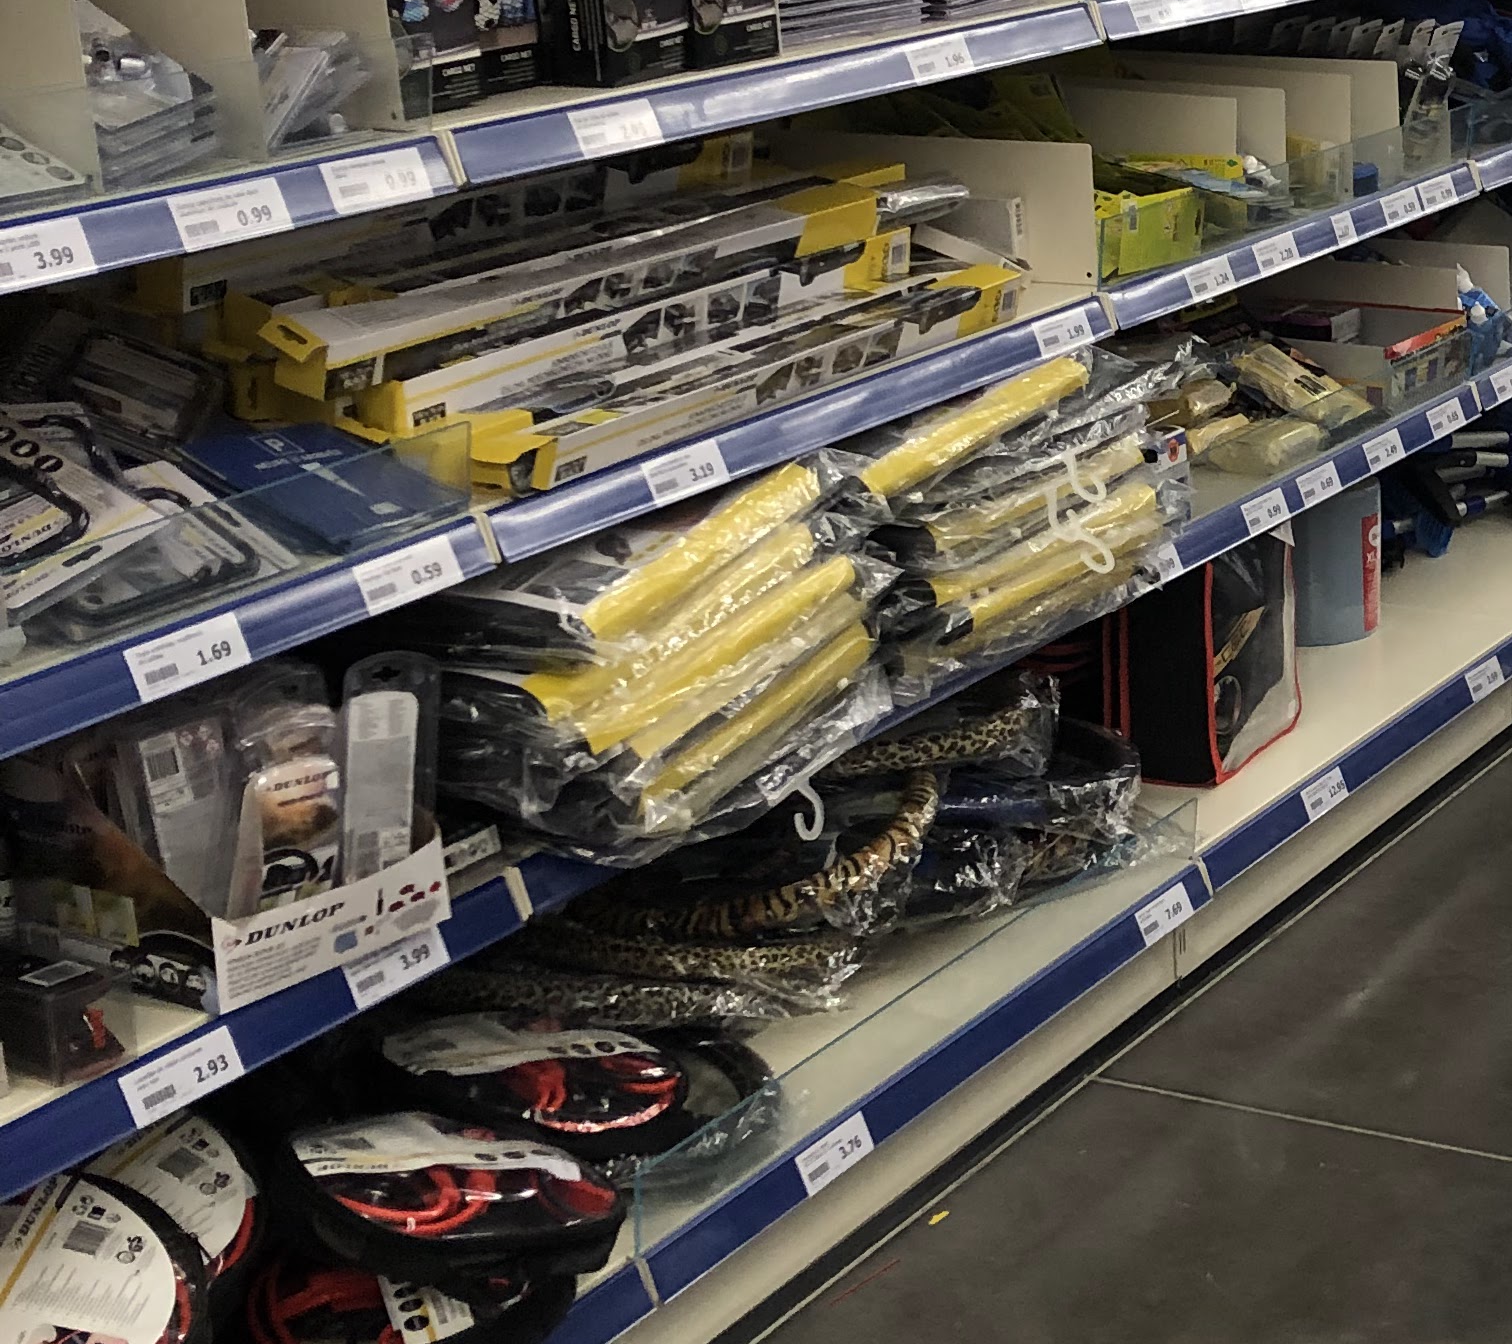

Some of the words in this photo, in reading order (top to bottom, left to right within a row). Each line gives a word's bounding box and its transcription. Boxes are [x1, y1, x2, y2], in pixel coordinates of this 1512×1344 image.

[386, 169, 418, 192] 0.99
[237, 203, 273, 228] 0.99
[33, 245, 75, 271] 3.99
[1066, 323, 1086, 341] 1.99
[690, 461, 714, 483] 3.19
[411, 561, 443, 586] 0.59
[196, 640, 232, 666] 1.69
[274, 771, 335, 792] DUNLOP
[1328, 778, 1346, 800] 12.95
[1163, 900, 1184, 922] 7.69
[244, 902, 346, 946] DUNLOP
[399, 943, 431, 972] 3.99
[193, 1054, 229, 1083] 2.93
[838, 1134, 864, 1161] 3.76
